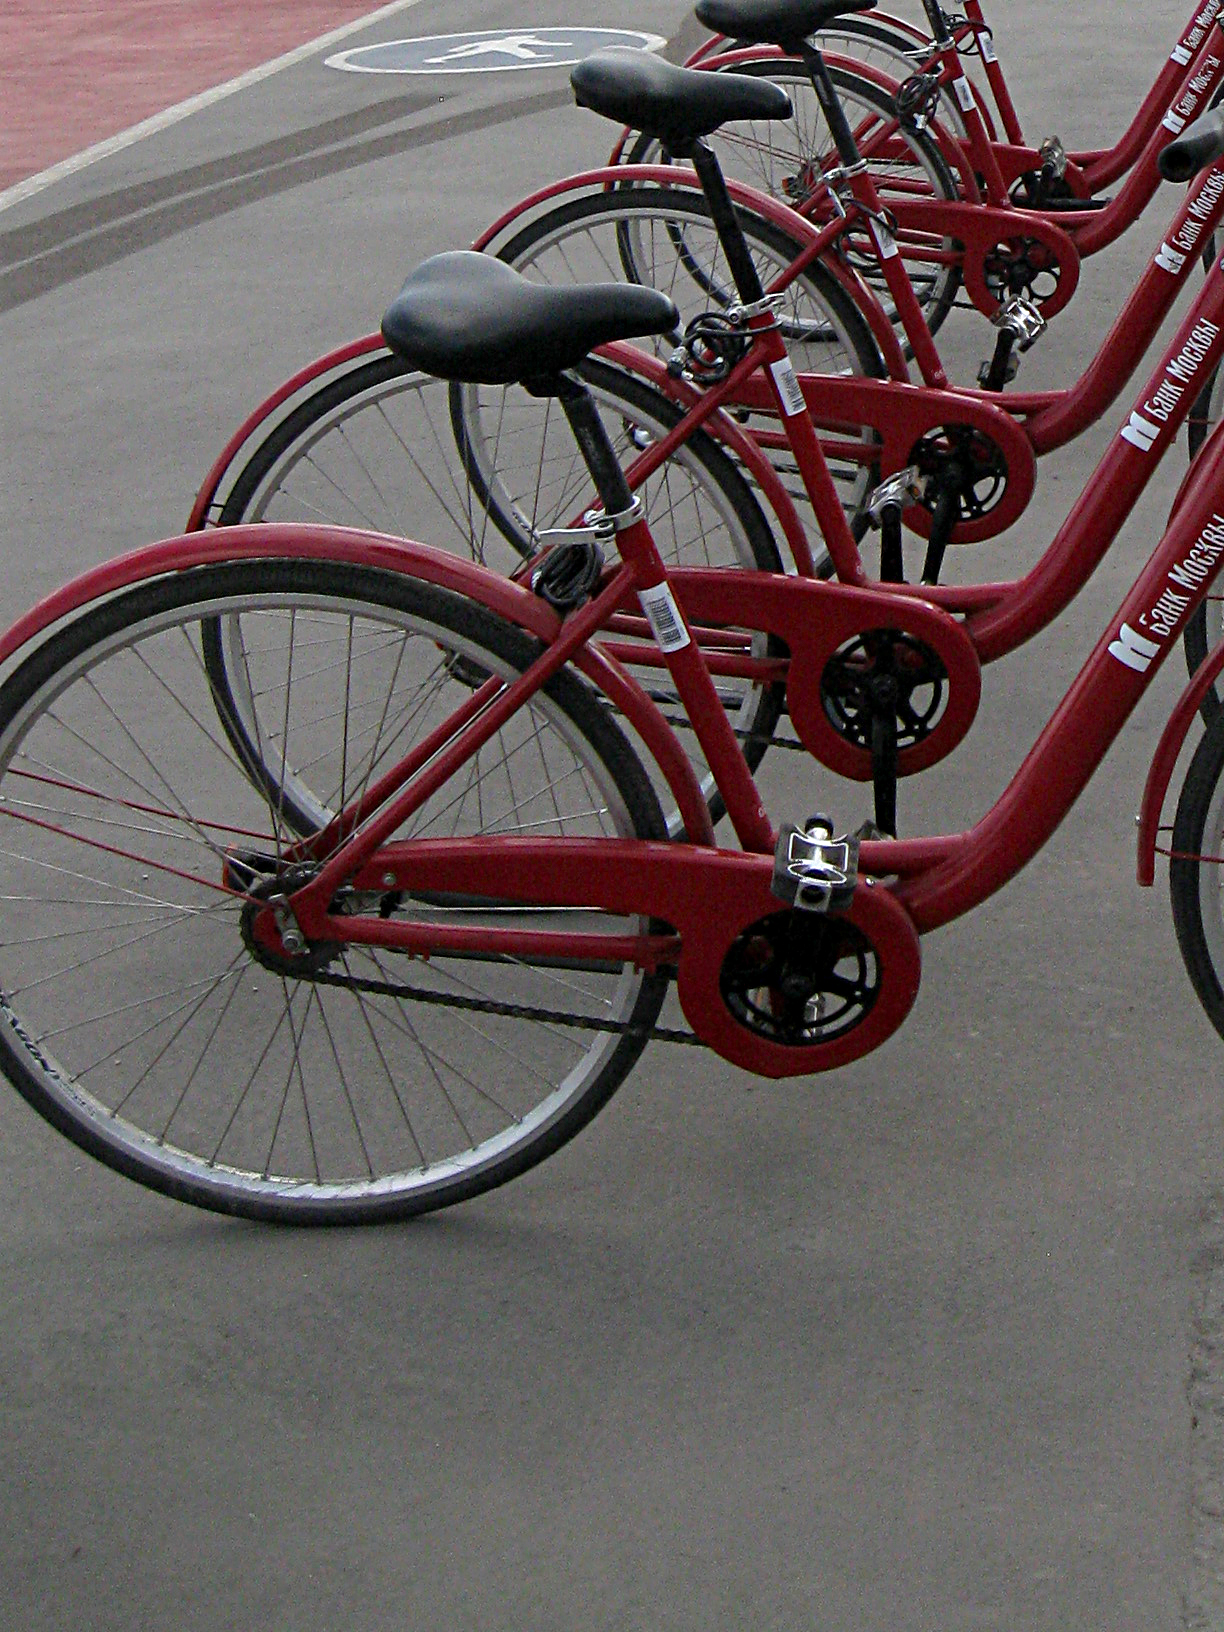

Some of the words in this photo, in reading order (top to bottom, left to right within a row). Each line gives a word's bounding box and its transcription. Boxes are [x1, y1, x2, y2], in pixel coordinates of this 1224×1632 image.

[1176, 88, 1199, 117] Банк
[1172, 219, 1203, 252] Банк
[1143, 377, 1185, 423] Банк
[1165, 317, 1221, 385] Москвы
[1138, 587, 1192, 638] Банк
